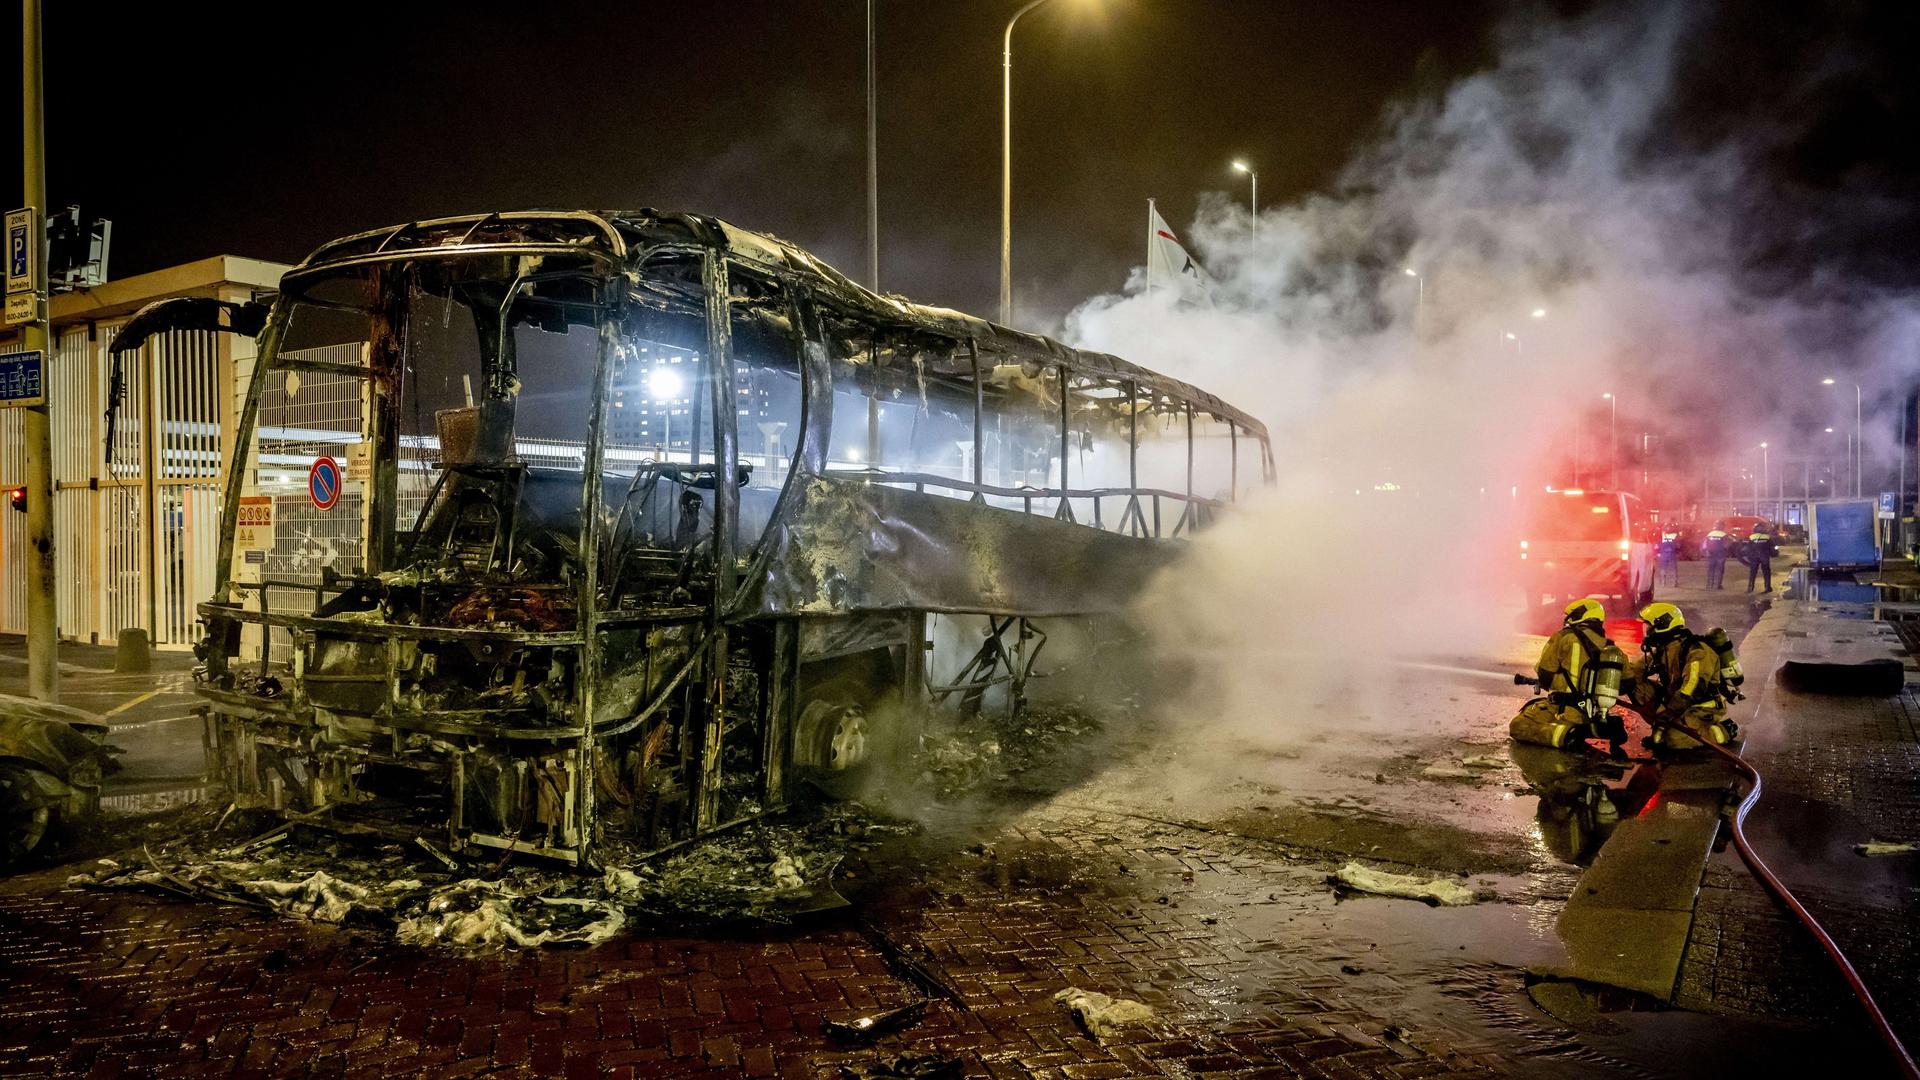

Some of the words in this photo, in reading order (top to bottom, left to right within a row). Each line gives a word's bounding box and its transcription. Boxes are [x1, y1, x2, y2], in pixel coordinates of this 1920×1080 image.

[12, 214, 26, 225] ZONE
[14, 237, 23, 260] P
[9, 281, 30, 289] herhaling
[1883, 495, 1891, 504] P
